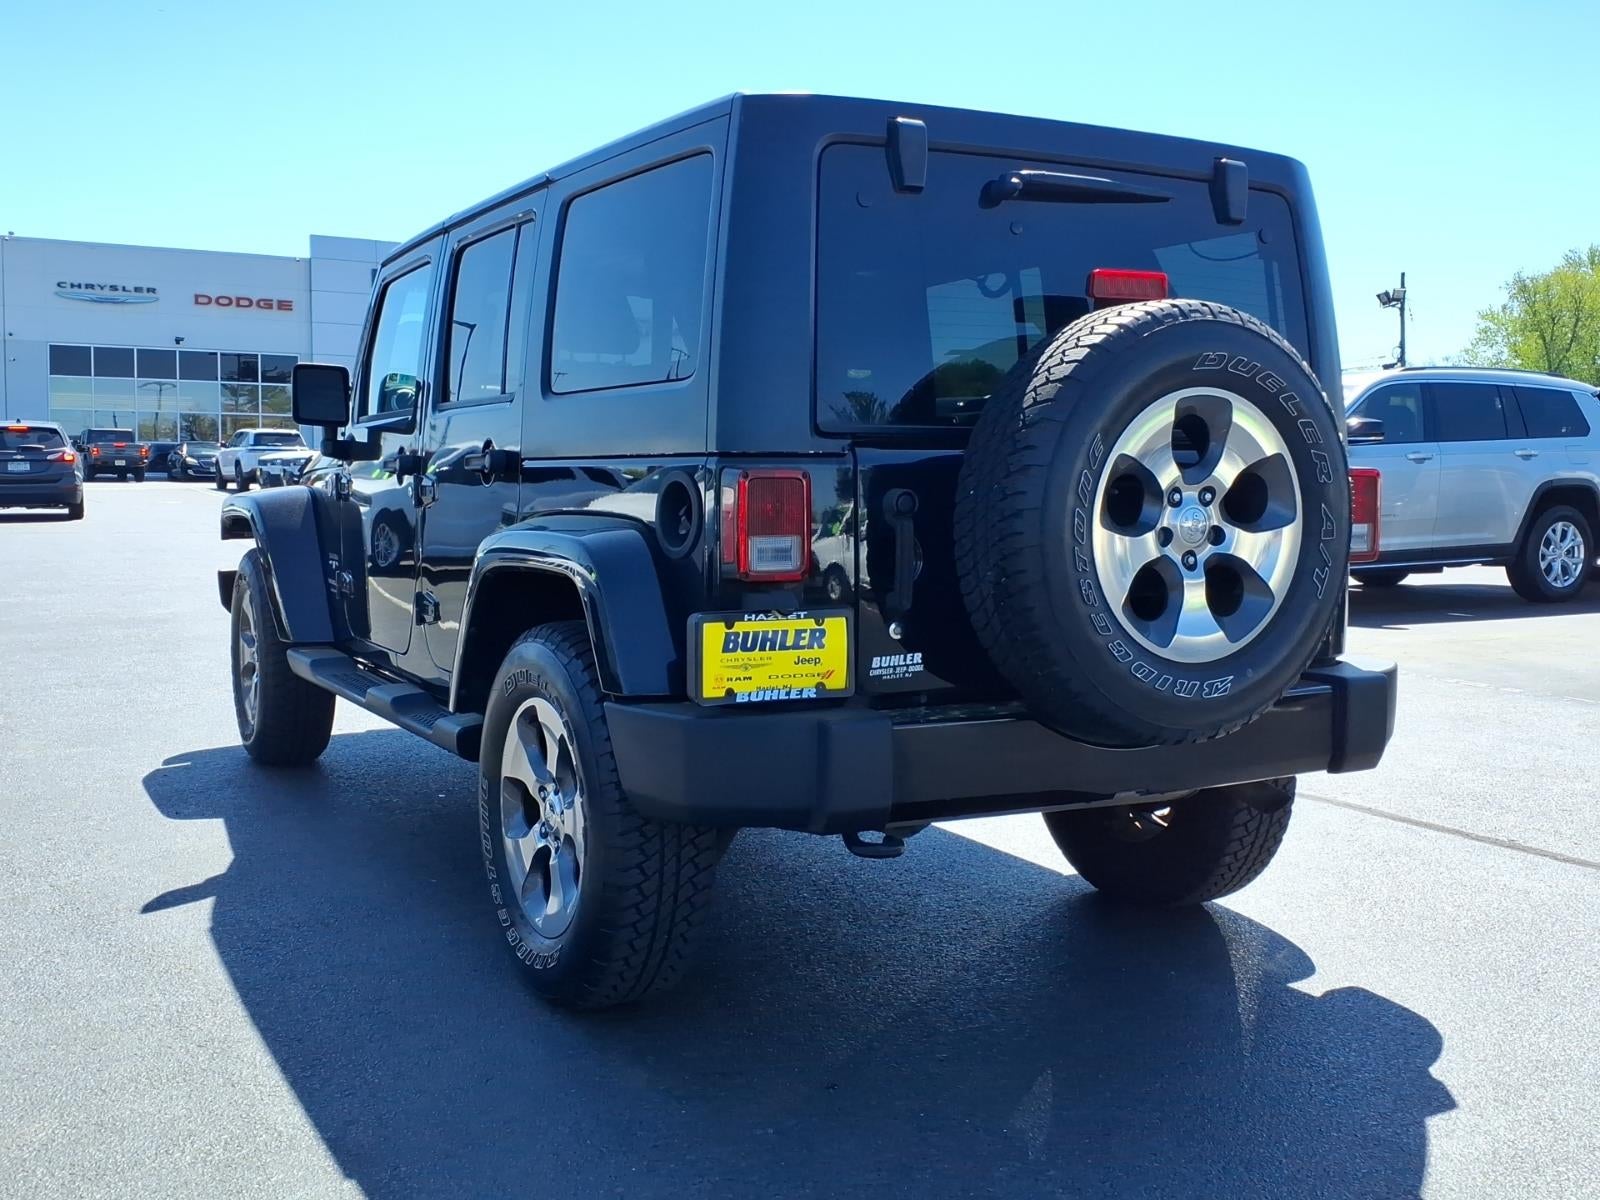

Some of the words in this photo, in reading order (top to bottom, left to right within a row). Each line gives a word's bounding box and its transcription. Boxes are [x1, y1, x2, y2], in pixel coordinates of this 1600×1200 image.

[56, 281, 157, 294] CHRYSLER
[194, 293, 293, 311] DODGE
[1193, 352, 1333, 484] DUELER
[1312, 502, 1337, 600] A/T
[1074, 433, 1233, 698] BRIDGESTONE
[744, 611, 807, 621] HAZLET
[722, 628, 826, 653] BUHLER
[794, 656, 821, 666] Jeep
[871, 652, 922, 668] BUHLER
[736, 688, 817, 702] BUHLER
